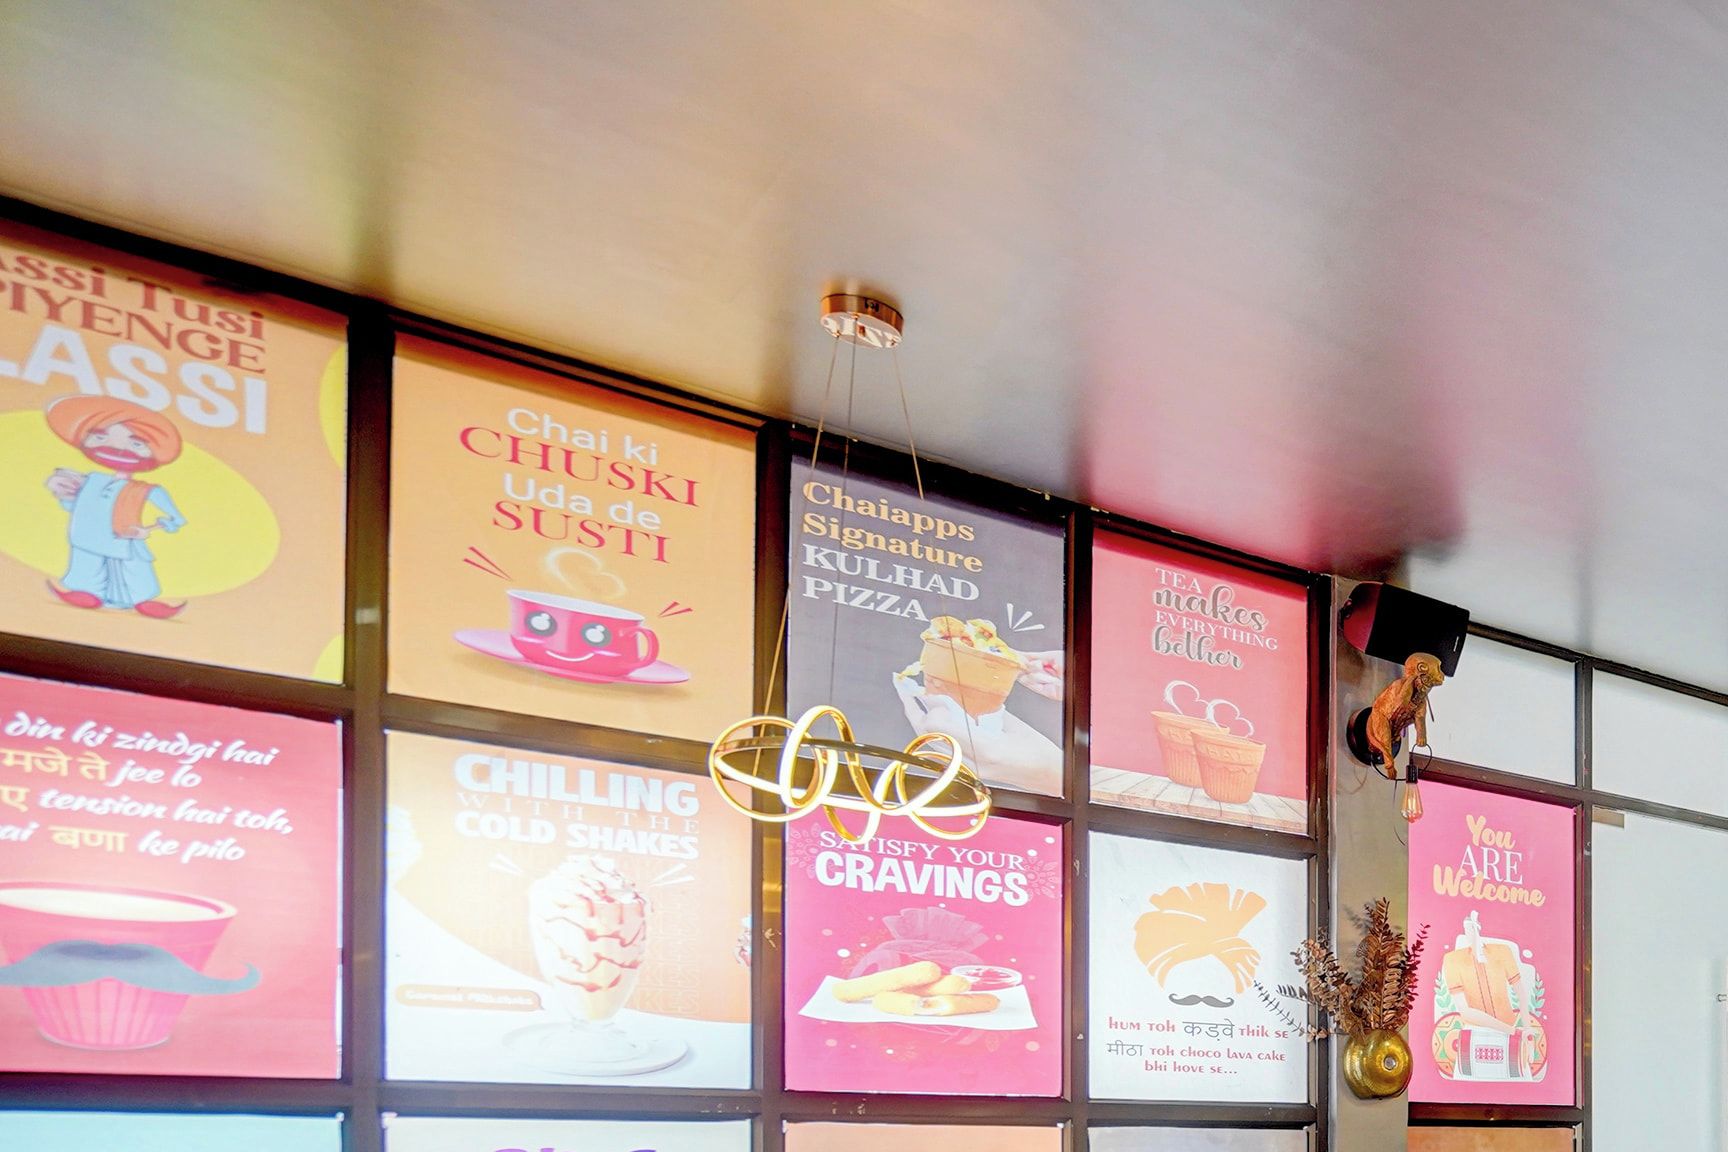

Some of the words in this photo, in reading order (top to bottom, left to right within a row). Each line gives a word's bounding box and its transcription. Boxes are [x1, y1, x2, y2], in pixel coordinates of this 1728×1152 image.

[0, 279, 266, 374] IYENGE
[507, 408, 609, 453] Chai
[623, 435, 658, 465] ki
[459, 426, 700, 507] CHUSKI
[503, 472, 593, 516] Uda
[608, 501, 662, 531] de
[802, 480, 975, 542] Chaiapps
[492, 500, 672, 564] SUSTI
[802, 511, 984, 573] Signature
[802, 543, 980, 601] KULHAD
[1155, 567, 1203, 595] TEA
[802, 575, 932, 623] PIZZA
[1154, 585, 1268, 632] makes
[1155, 610, 1280, 650] EVERYTHING
[171, 763, 203, 789] lo
[221, 739, 280, 768] hai
[38, 788, 168, 819] tension
[173, 798, 226, 826] hai
[454, 753, 700, 818] CHILLING
[454, 810, 557, 845] COLD
[565, 822, 700, 860] SHAKES
[456, 791, 585, 821] WITH
[615, 810, 700, 835] THE
[1465, 813, 1516, 850] You
[137, 831, 179, 857] ke
[181, 837, 247, 864] pilo
[947, 846, 1026, 871] YOUR
[1457, 845, 1525, 886] ARE
[815, 850, 1030, 907] CRAVINGS
[1432, 864, 1546, 907] Welcome
